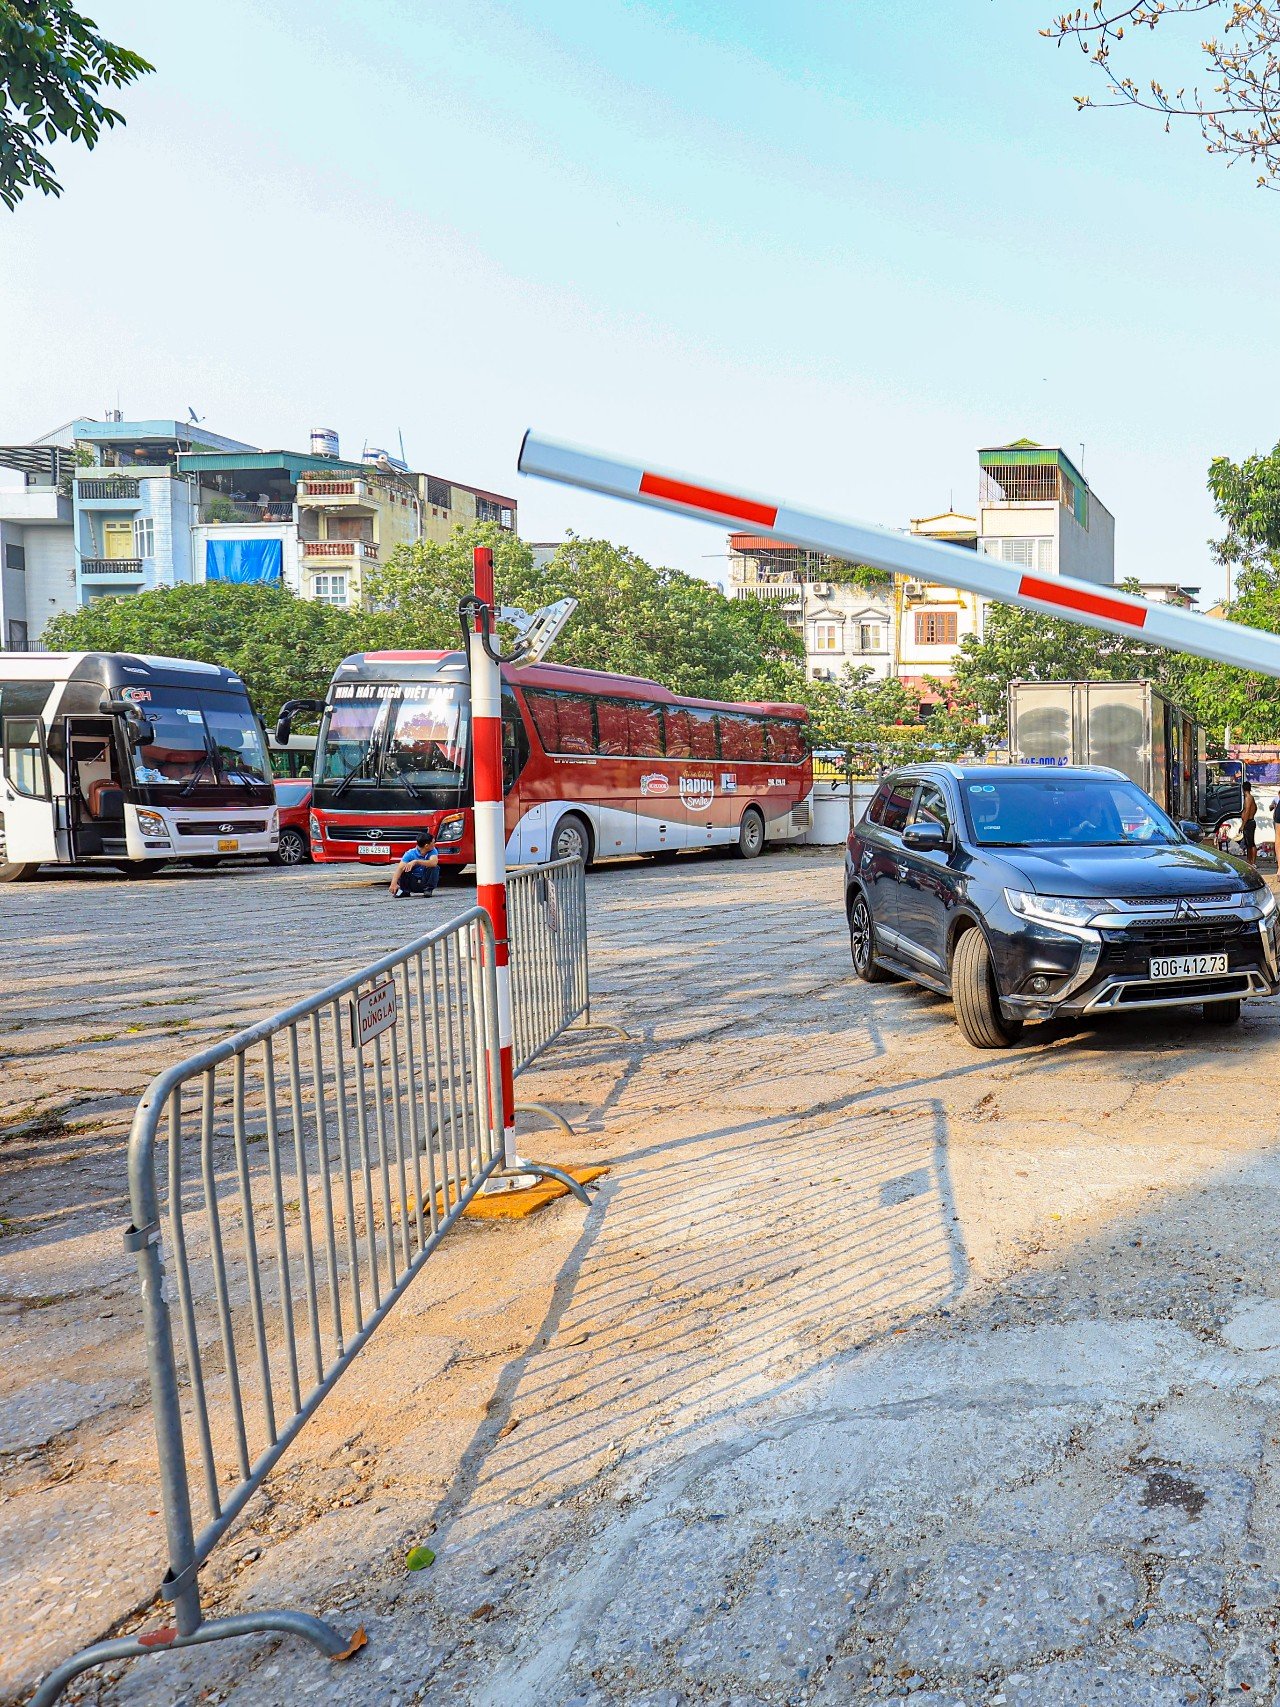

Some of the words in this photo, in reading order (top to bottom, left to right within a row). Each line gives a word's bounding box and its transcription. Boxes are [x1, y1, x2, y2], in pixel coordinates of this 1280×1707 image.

[427, 687, 455, 699] NAM
[679, 776, 714, 794] happy
[1152, 957, 1226, 977] 30G-412.73
